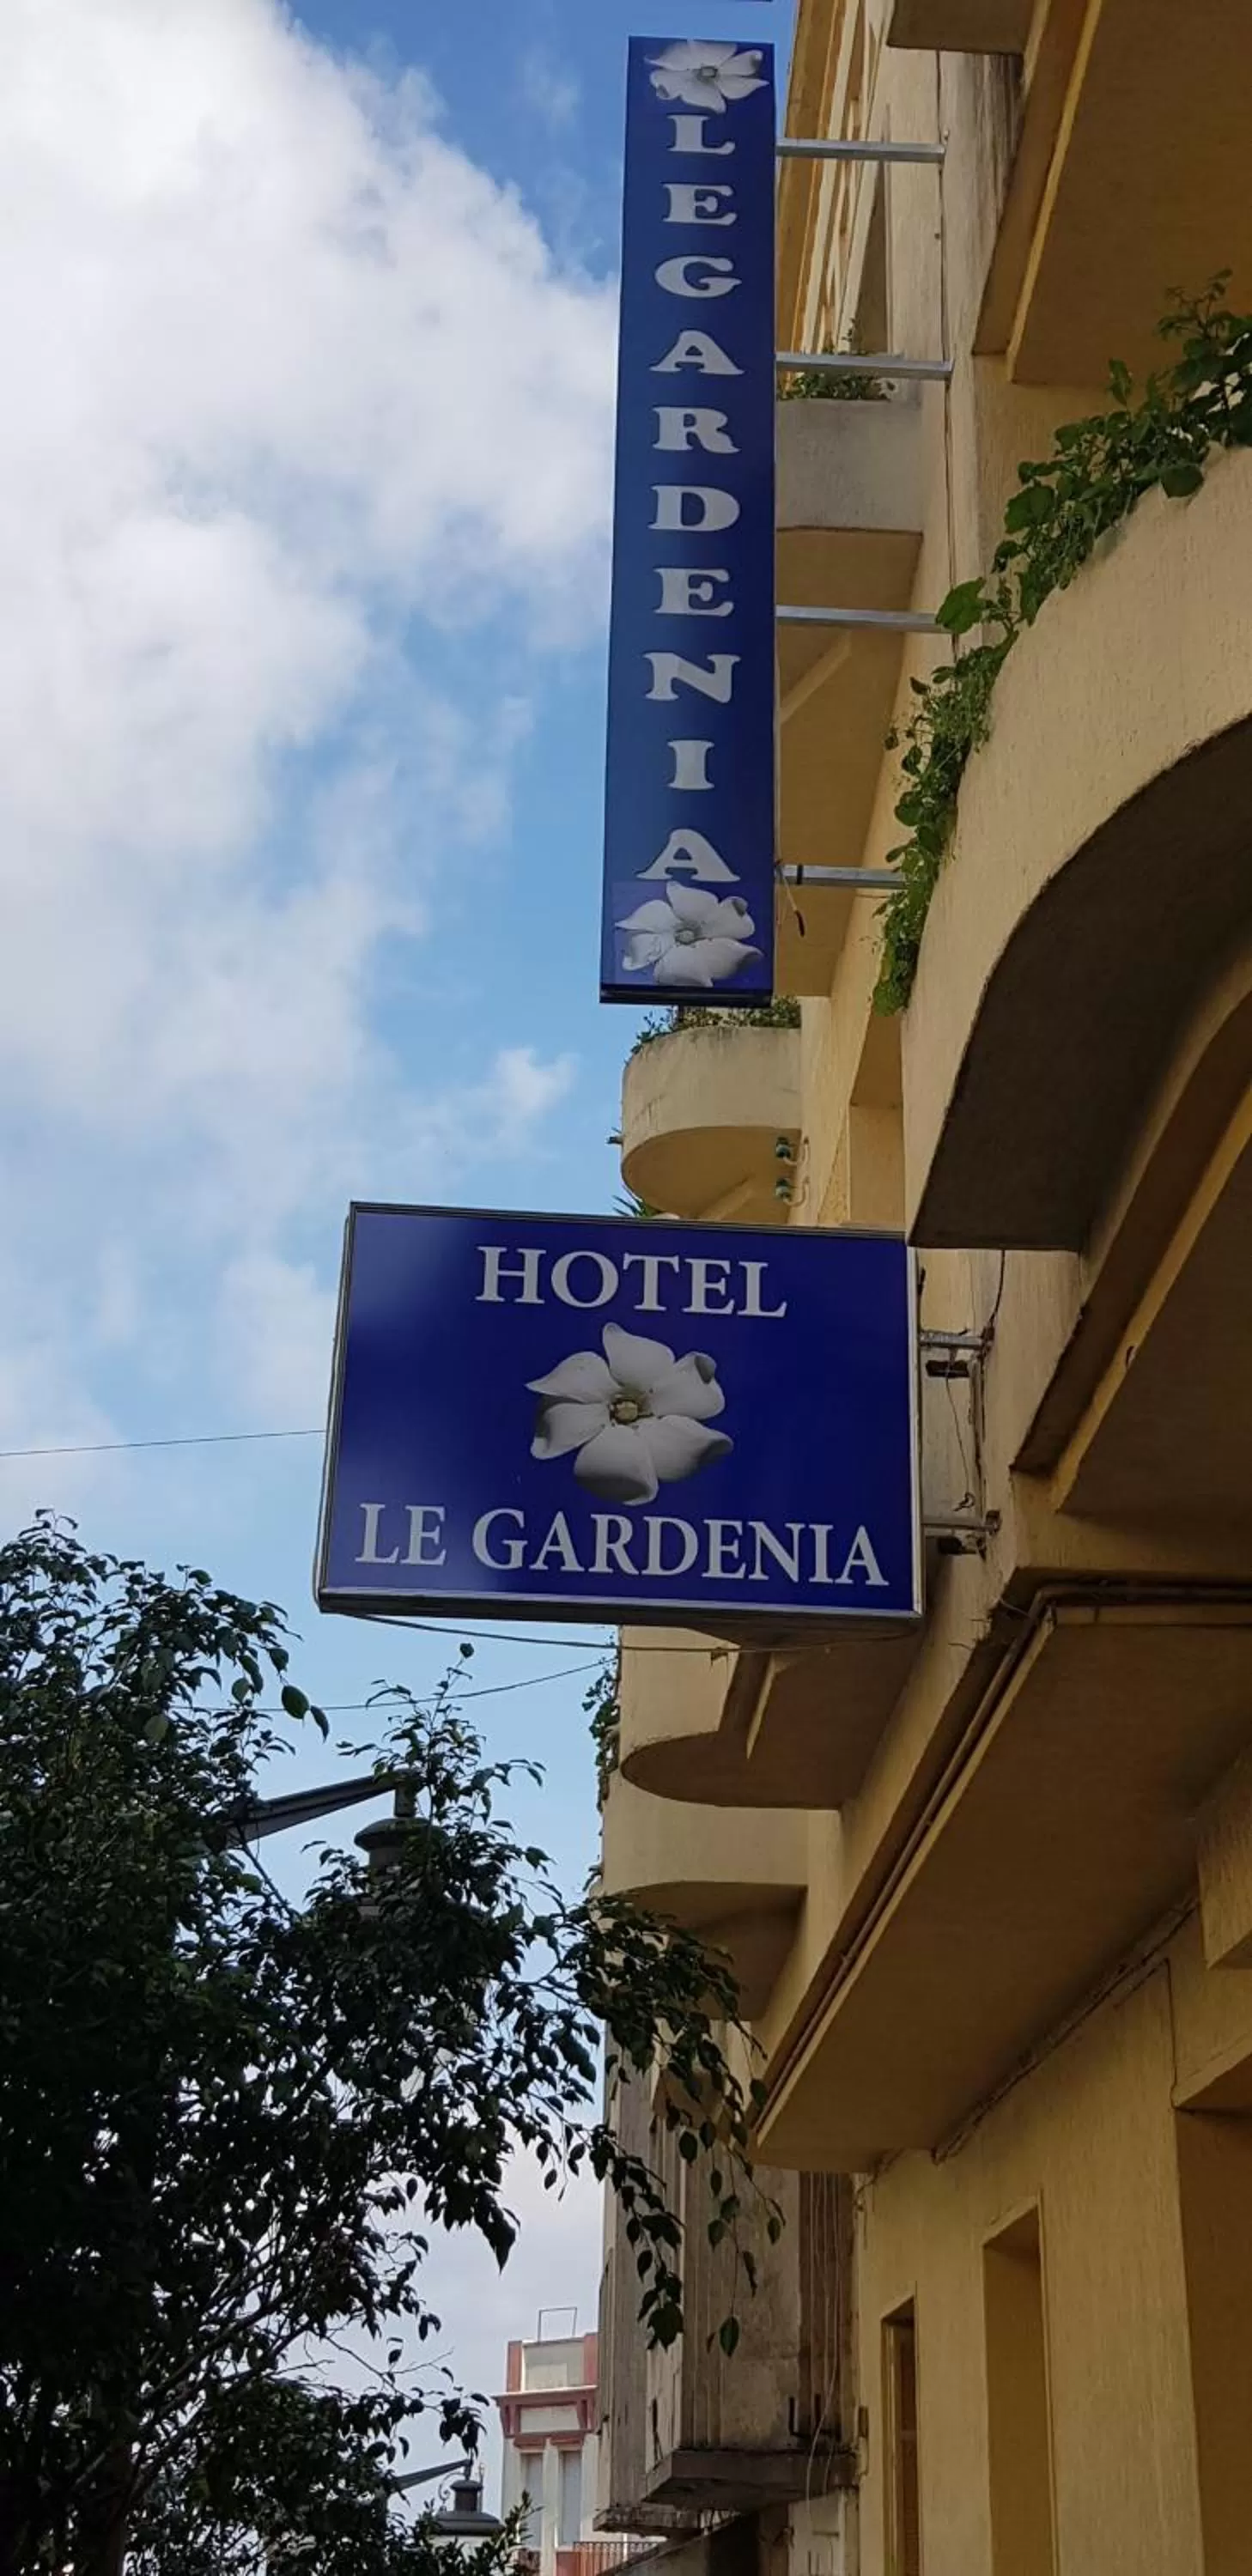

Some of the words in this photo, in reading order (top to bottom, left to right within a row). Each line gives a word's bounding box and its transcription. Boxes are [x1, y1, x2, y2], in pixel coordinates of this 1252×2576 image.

[475, 1245, 788, 1318] HOTEL
[354, 1503, 447, 1566] LE
[471, 1508, 890, 1587] GARDENIA
